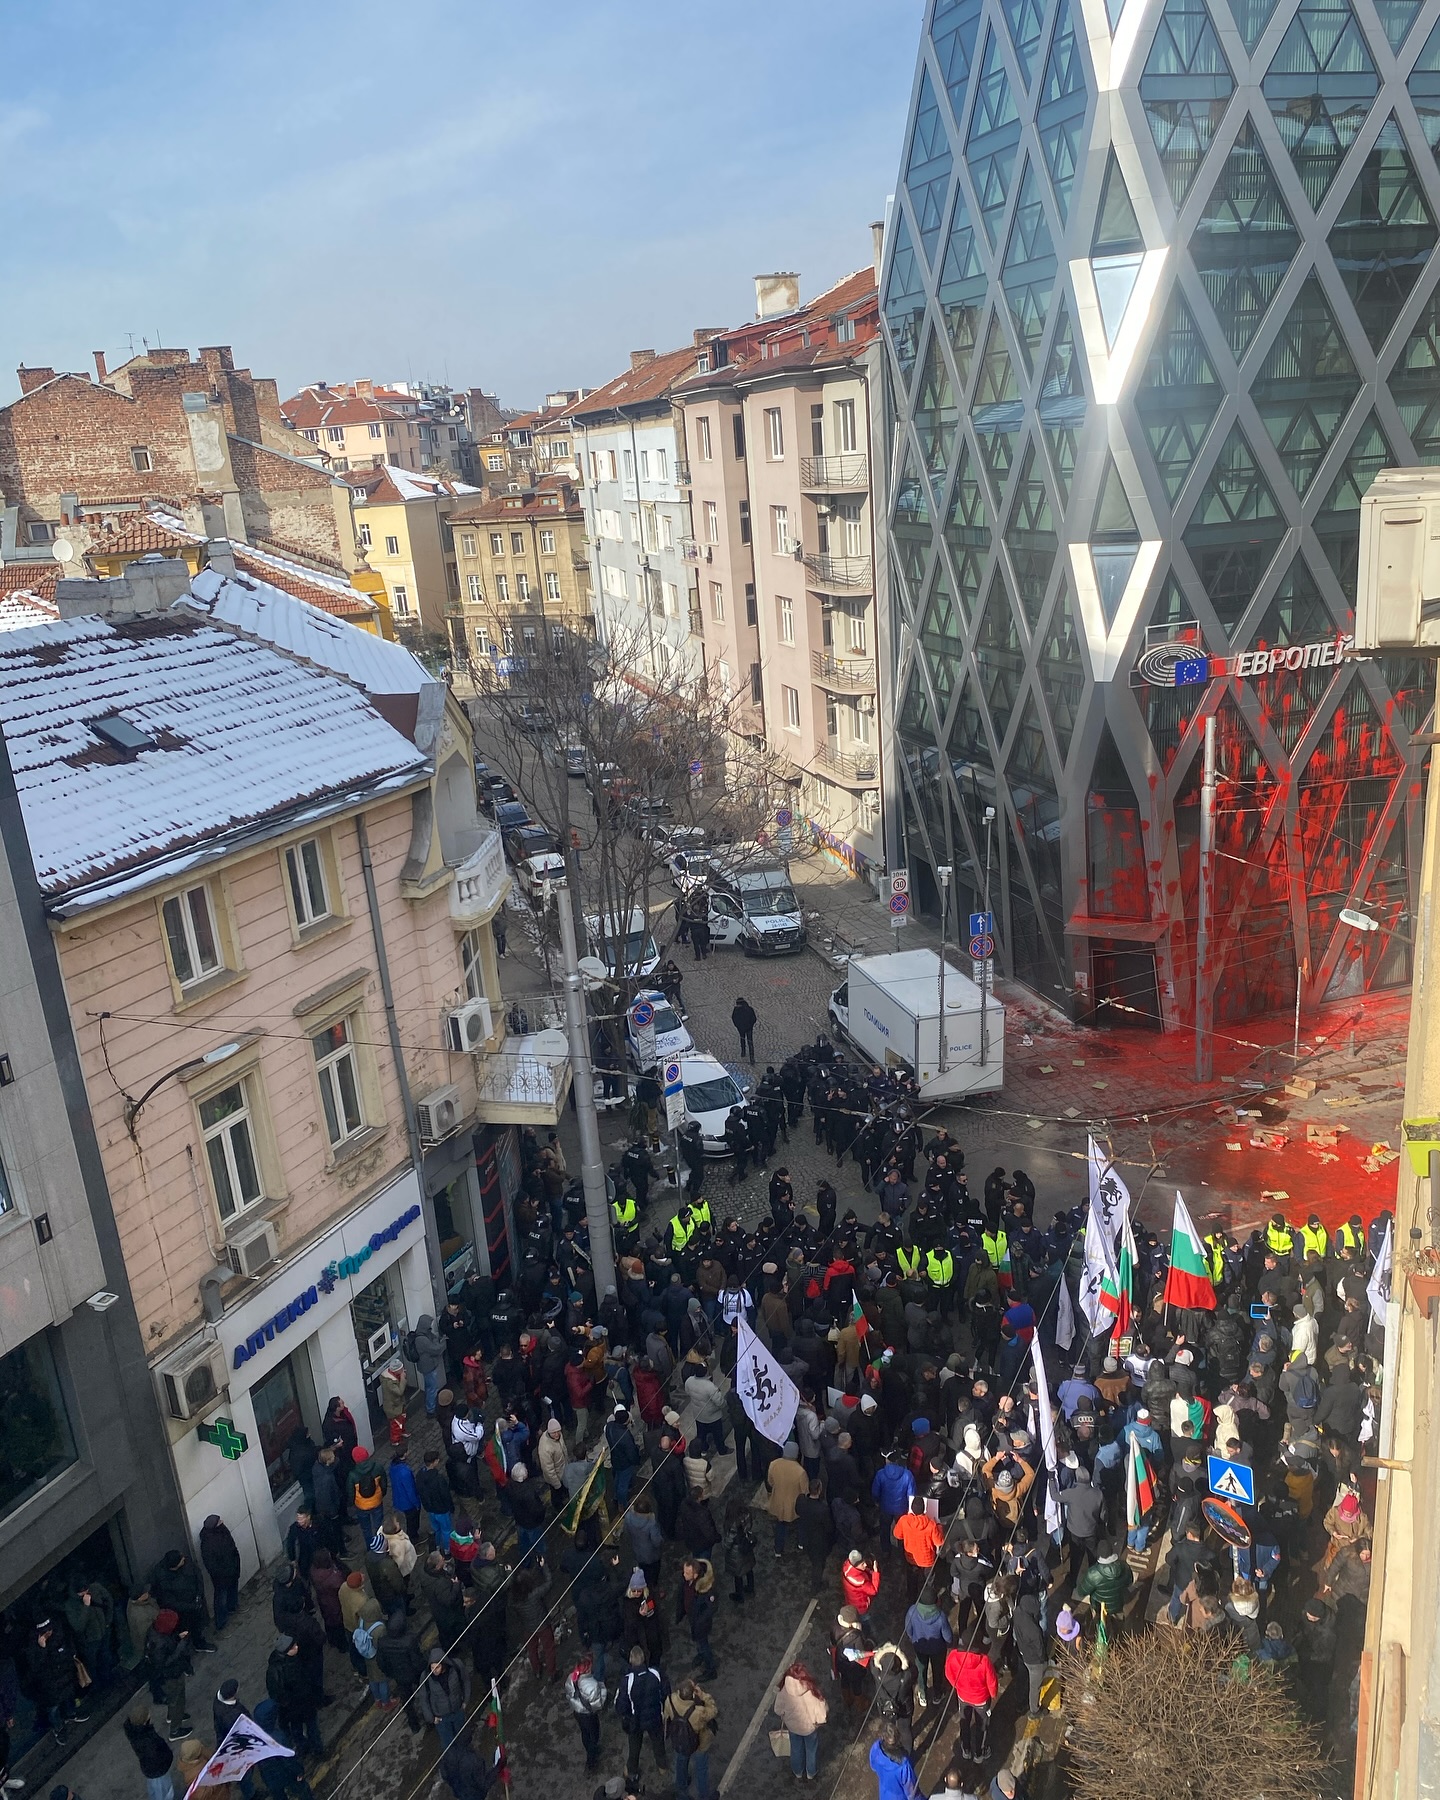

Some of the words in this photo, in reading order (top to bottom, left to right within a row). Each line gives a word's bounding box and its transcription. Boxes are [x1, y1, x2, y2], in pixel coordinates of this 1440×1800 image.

[1235, 634, 1382, 677] ЕВРОПЕЙ
[895, 880, 904, 889] 30
[863, 1007, 890, 1039] ПОЛИЦИЯ
[949, 1043, 973, 1052] POLICE
[233, 1285, 319, 1370] АПТЕКИ
